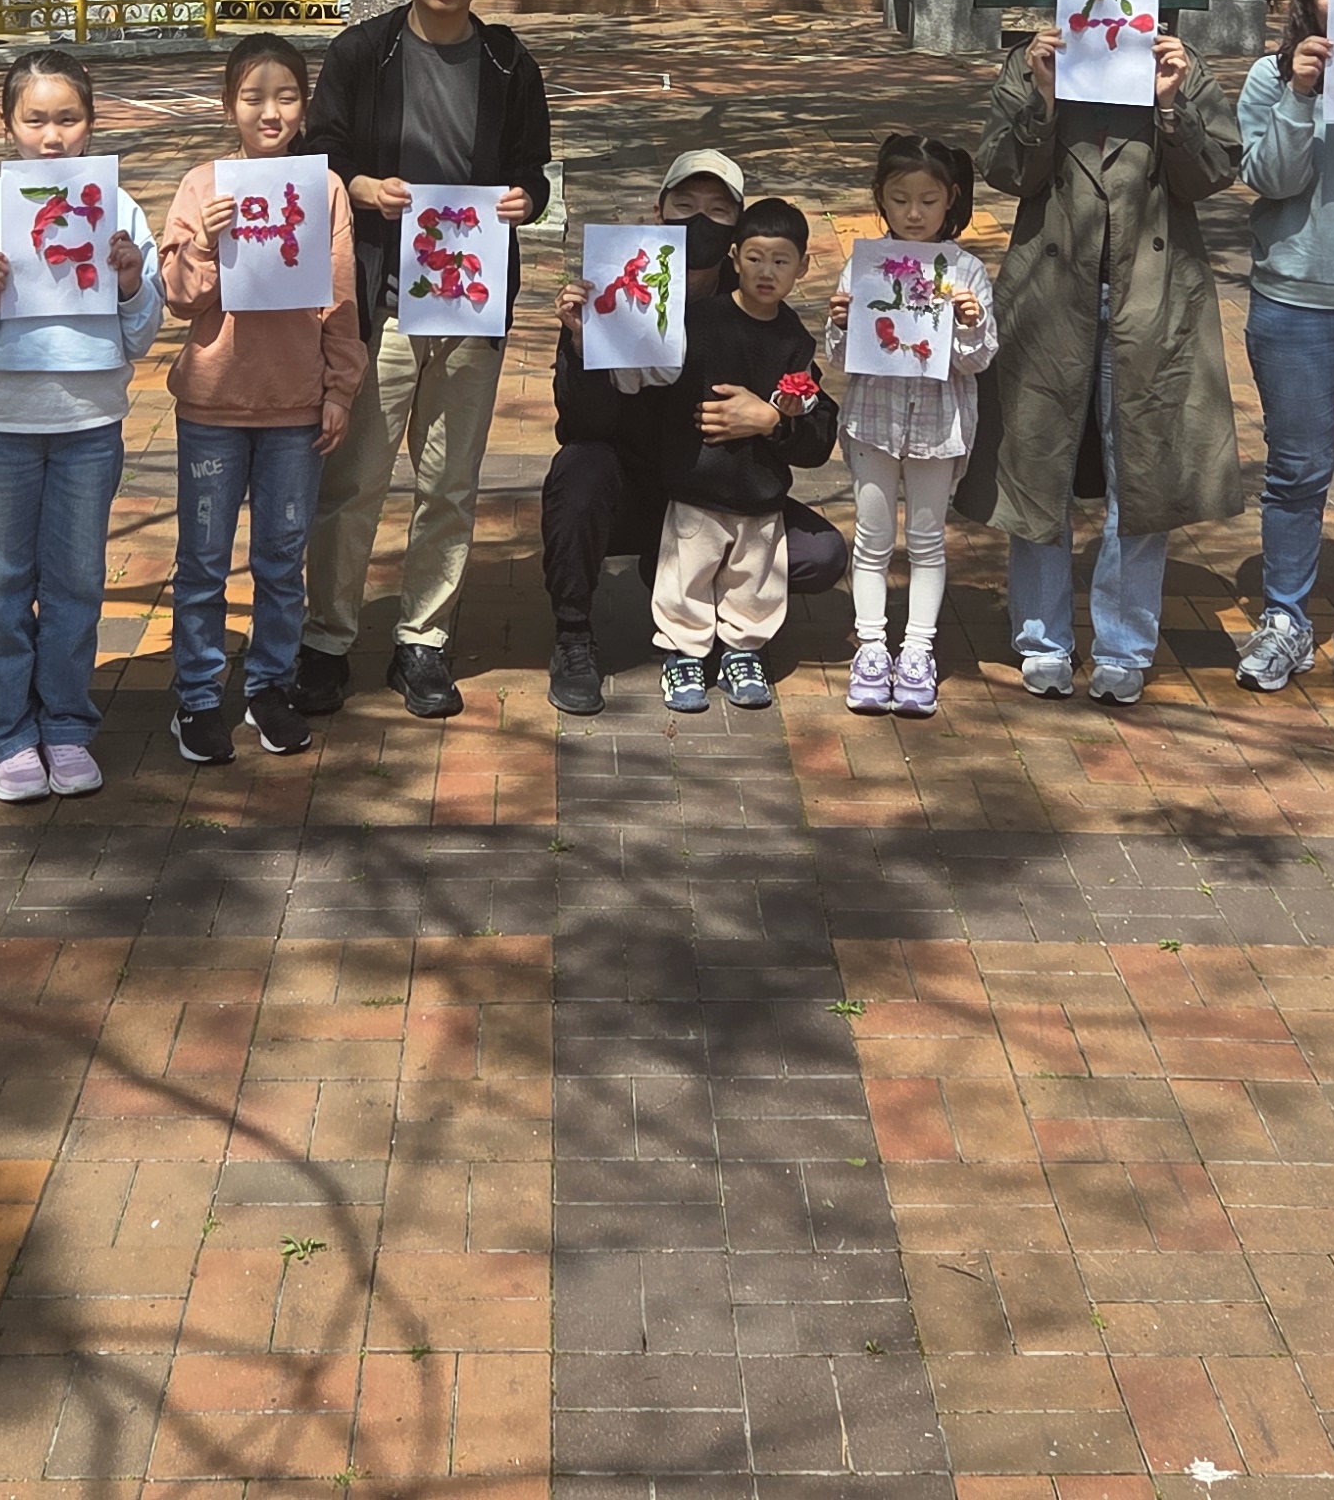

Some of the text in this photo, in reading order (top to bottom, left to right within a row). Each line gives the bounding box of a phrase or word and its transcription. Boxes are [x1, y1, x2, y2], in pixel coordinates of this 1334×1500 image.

[230, 182, 306, 268] 의
[407, 205, 490, 303] 도
[593, 244, 676, 334] 서
[190, 457, 224, 479] NICE
